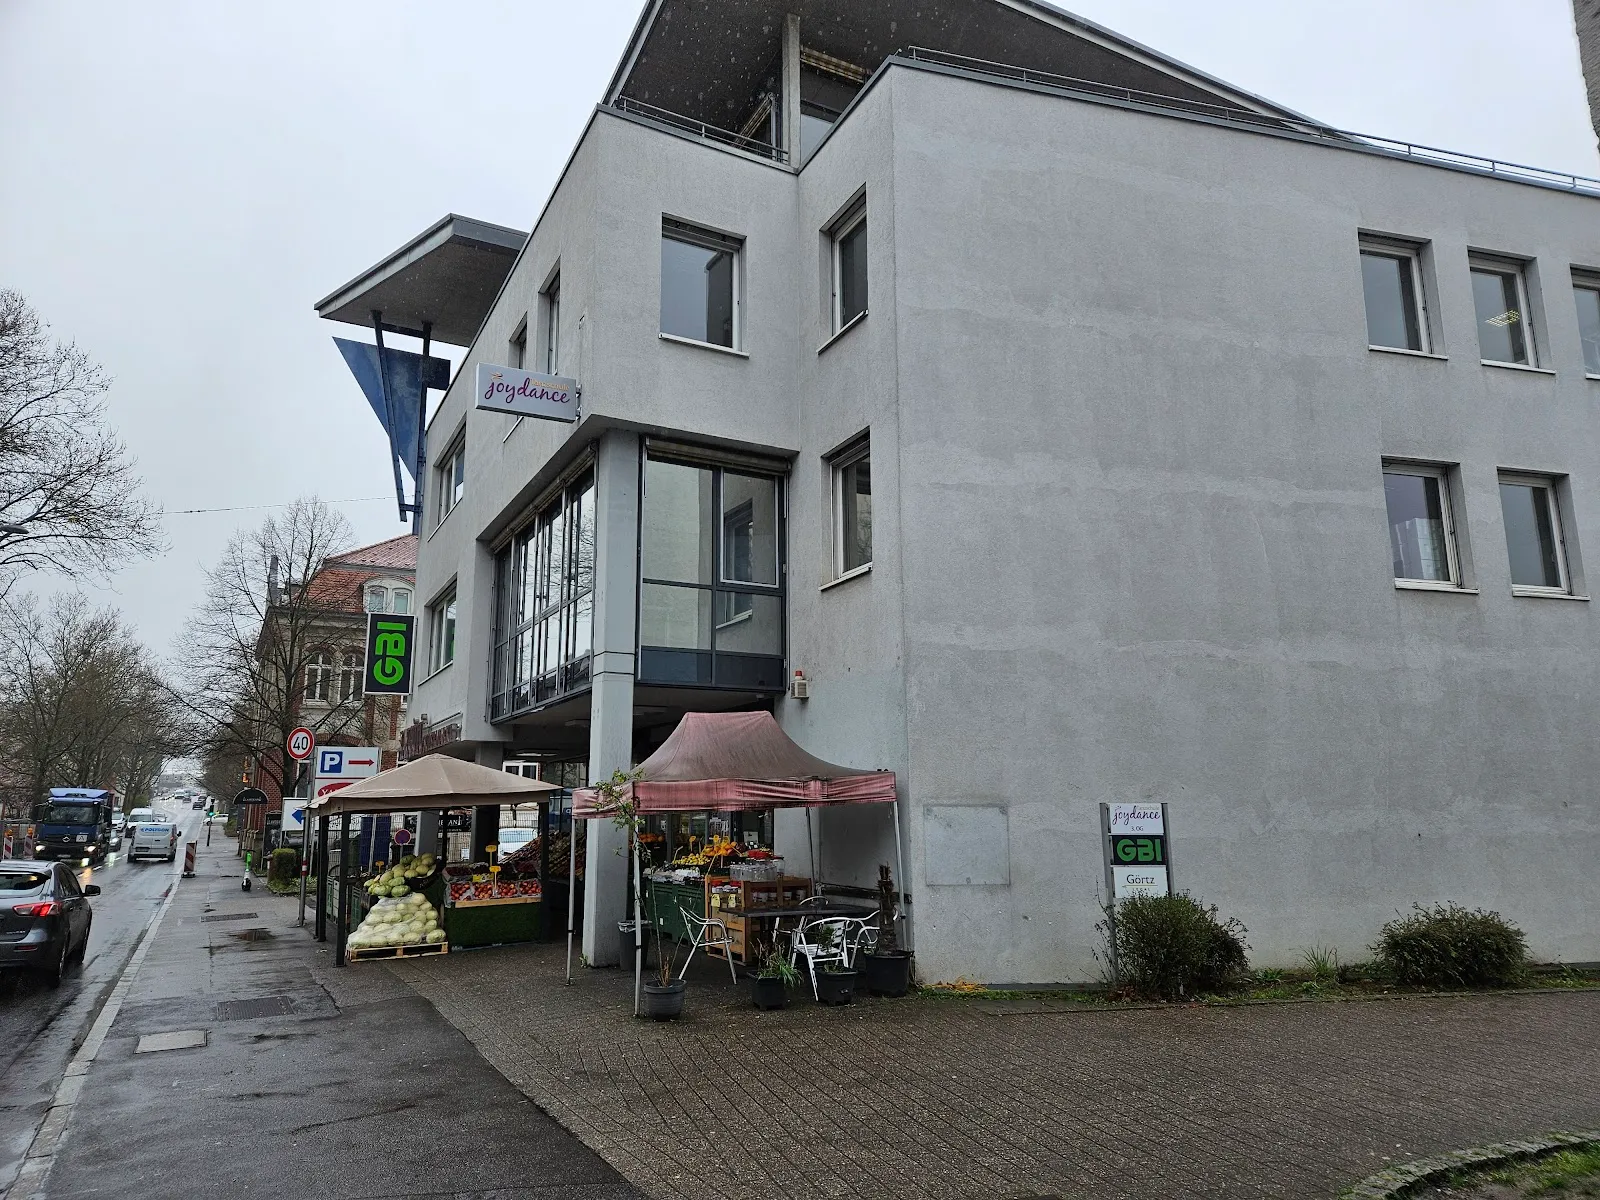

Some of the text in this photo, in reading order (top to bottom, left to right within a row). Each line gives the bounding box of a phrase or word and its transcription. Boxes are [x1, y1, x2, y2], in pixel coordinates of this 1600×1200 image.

[485, 377, 571, 404] joydance
[373, 622, 407, 685] GBI
[293, 736, 309, 751] 40
[324, 753, 340, 771] P
[1112, 806, 1160, 825] joydance
[1117, 839, 1162, 861] GBI
[1126, 874, 1155, 884] Görtz
